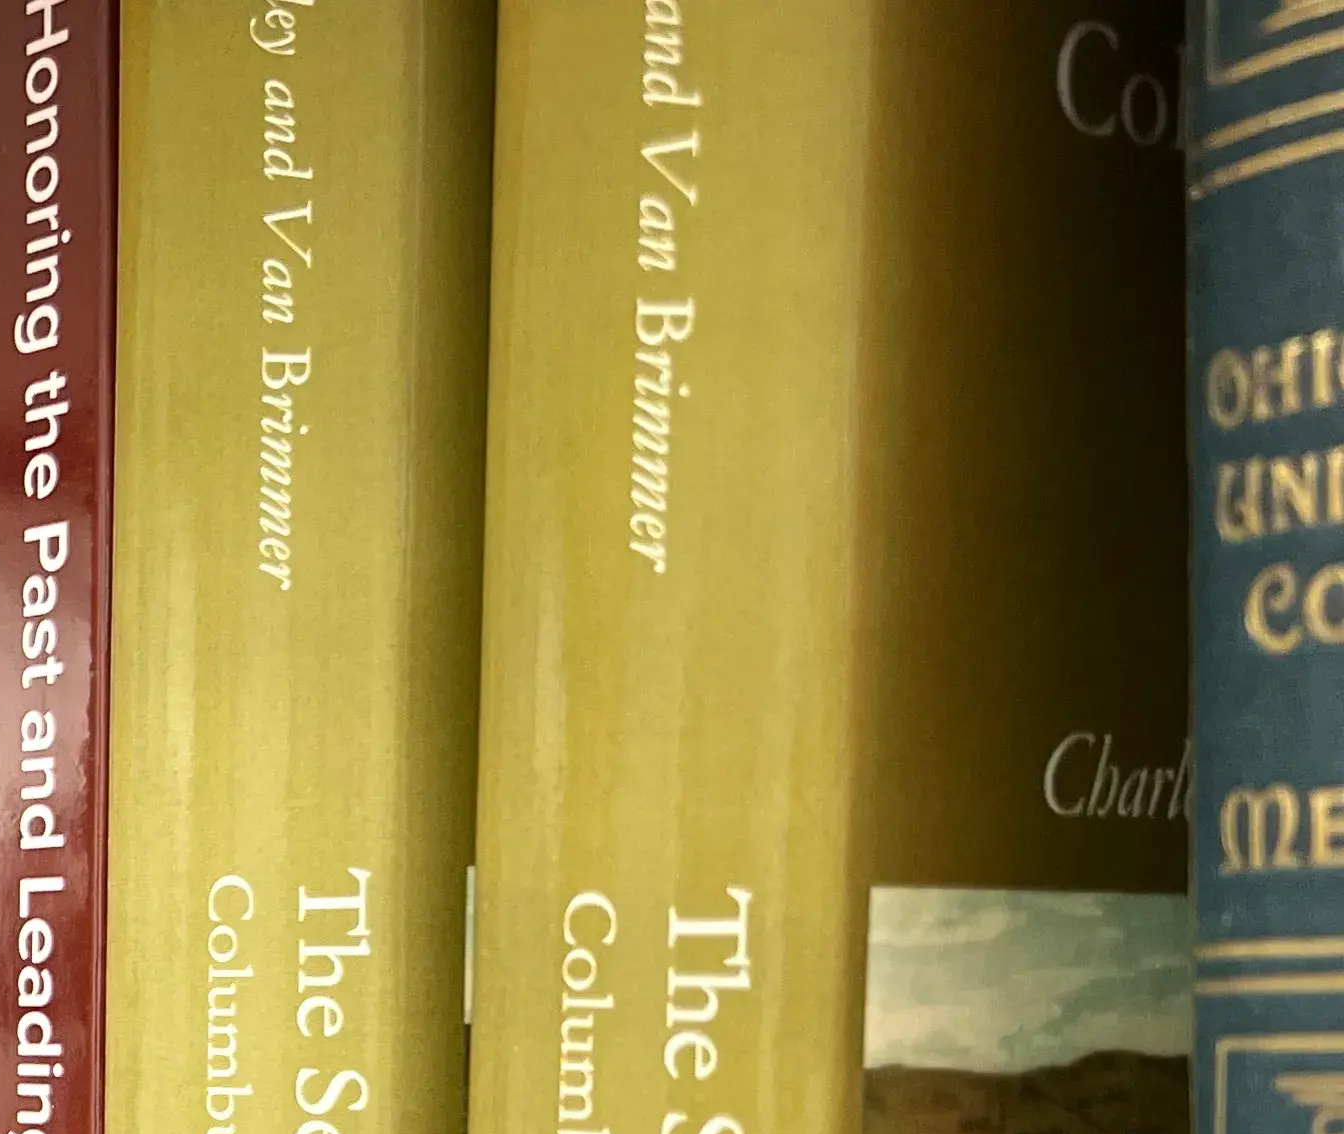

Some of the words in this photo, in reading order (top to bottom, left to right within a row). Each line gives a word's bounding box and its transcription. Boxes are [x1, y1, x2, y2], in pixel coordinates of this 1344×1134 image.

[263, 79, 313, 182] and
[643, 0, 704, 107] and
[15, 0, 71, 355] Honoring
[637, 130, 703, 273] Van
[263, 199, 313, 325] Van
[23, 370, 70, 501] the
[257, 346, 312, 592] Brimmer
[628, 296, 697, 577] Brimmer
[21, 520, 69, 689] Past
[20, 709, 65, 850] and
[297, 866, 372, 1040] The
[664, 886, 754, 1081] The
